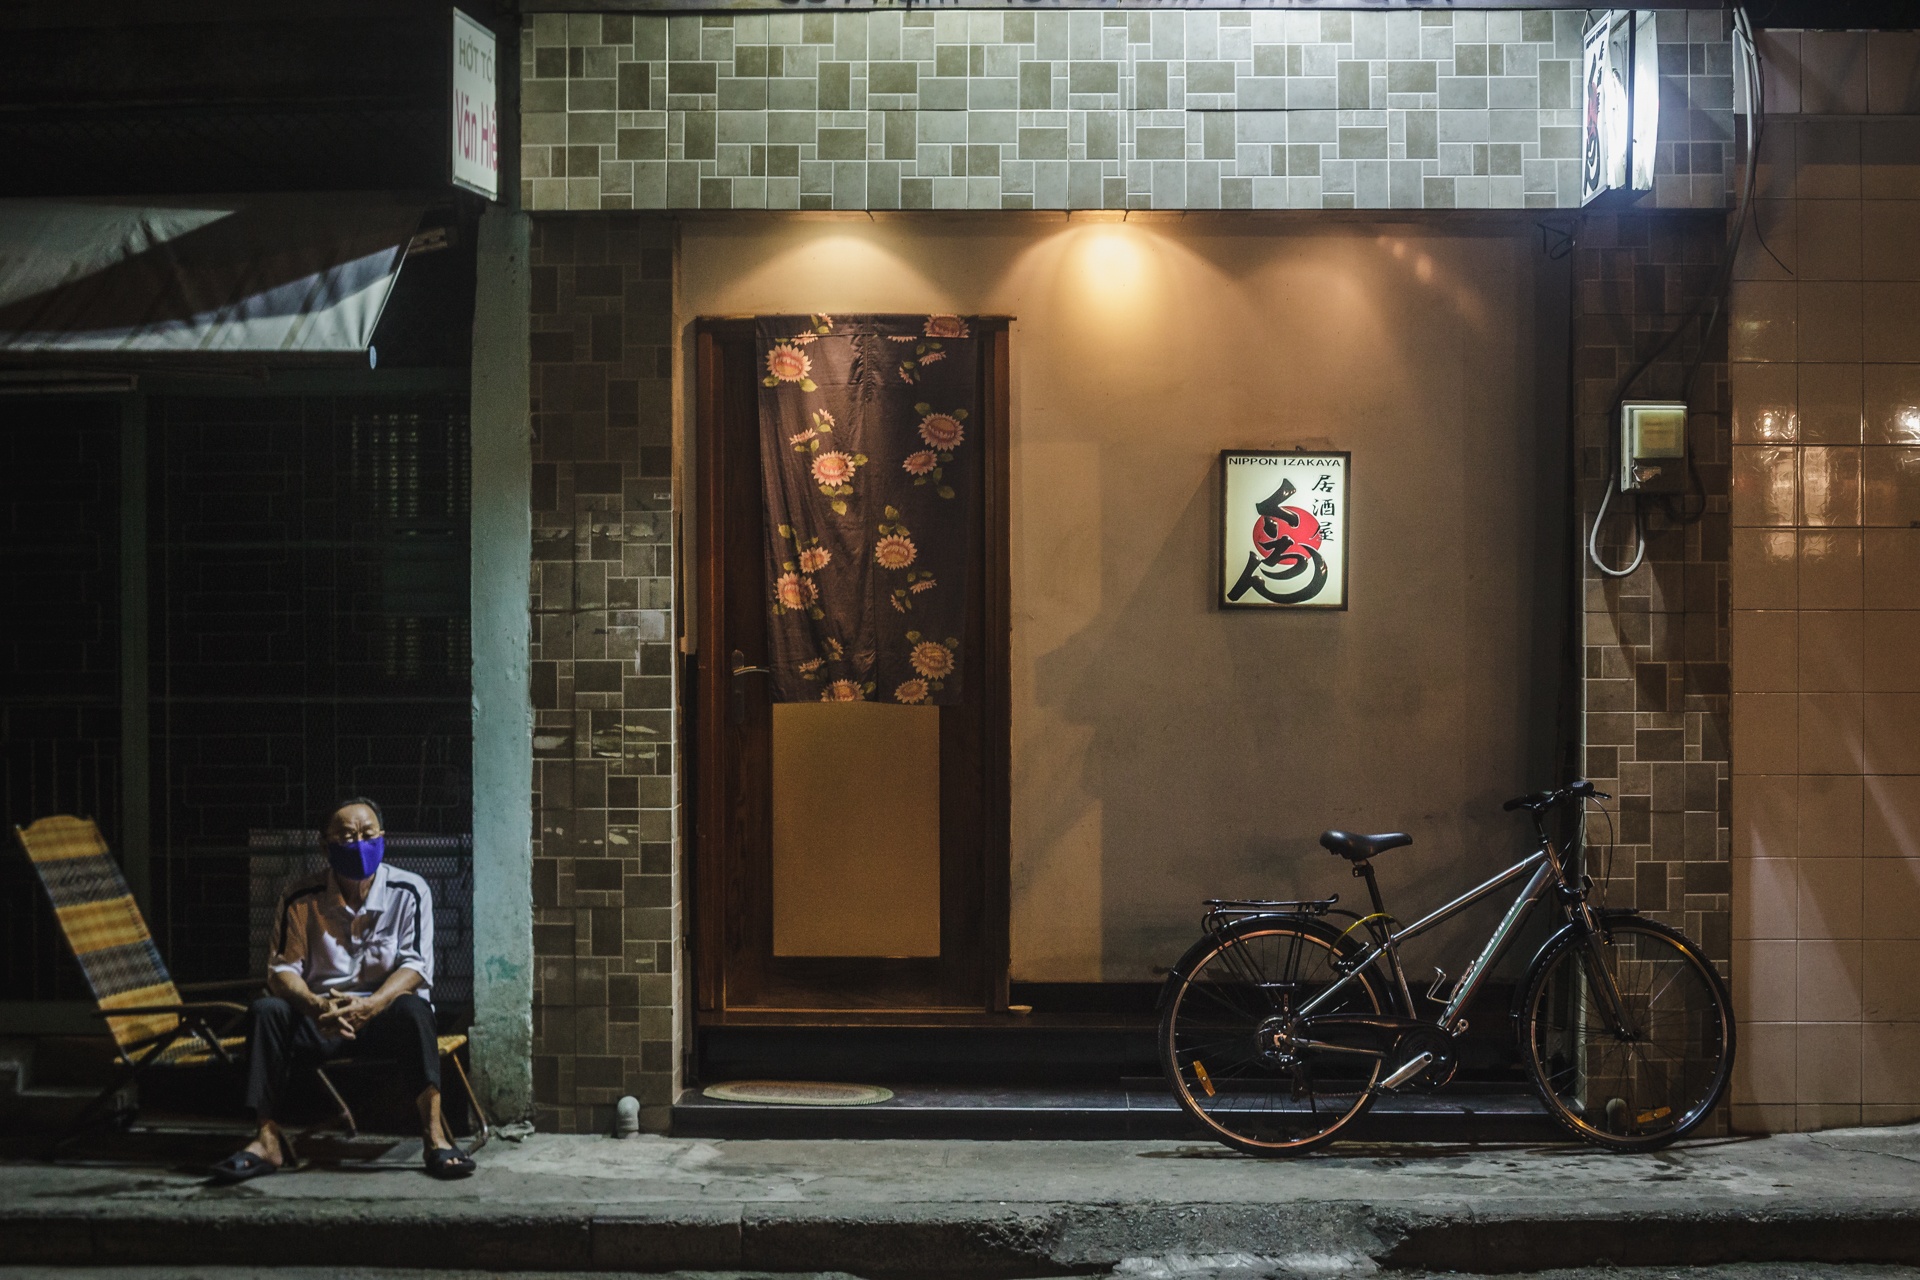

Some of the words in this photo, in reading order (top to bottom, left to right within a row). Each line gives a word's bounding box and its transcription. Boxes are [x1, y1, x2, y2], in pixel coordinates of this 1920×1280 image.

[481, 48, 493, 84] TÓ
[1228, 457, 1278, 466] NIPPON
[1283, 458, 1341, 467] IZAKAYA
[1310, 474, 1336, 542] 居酒屋
